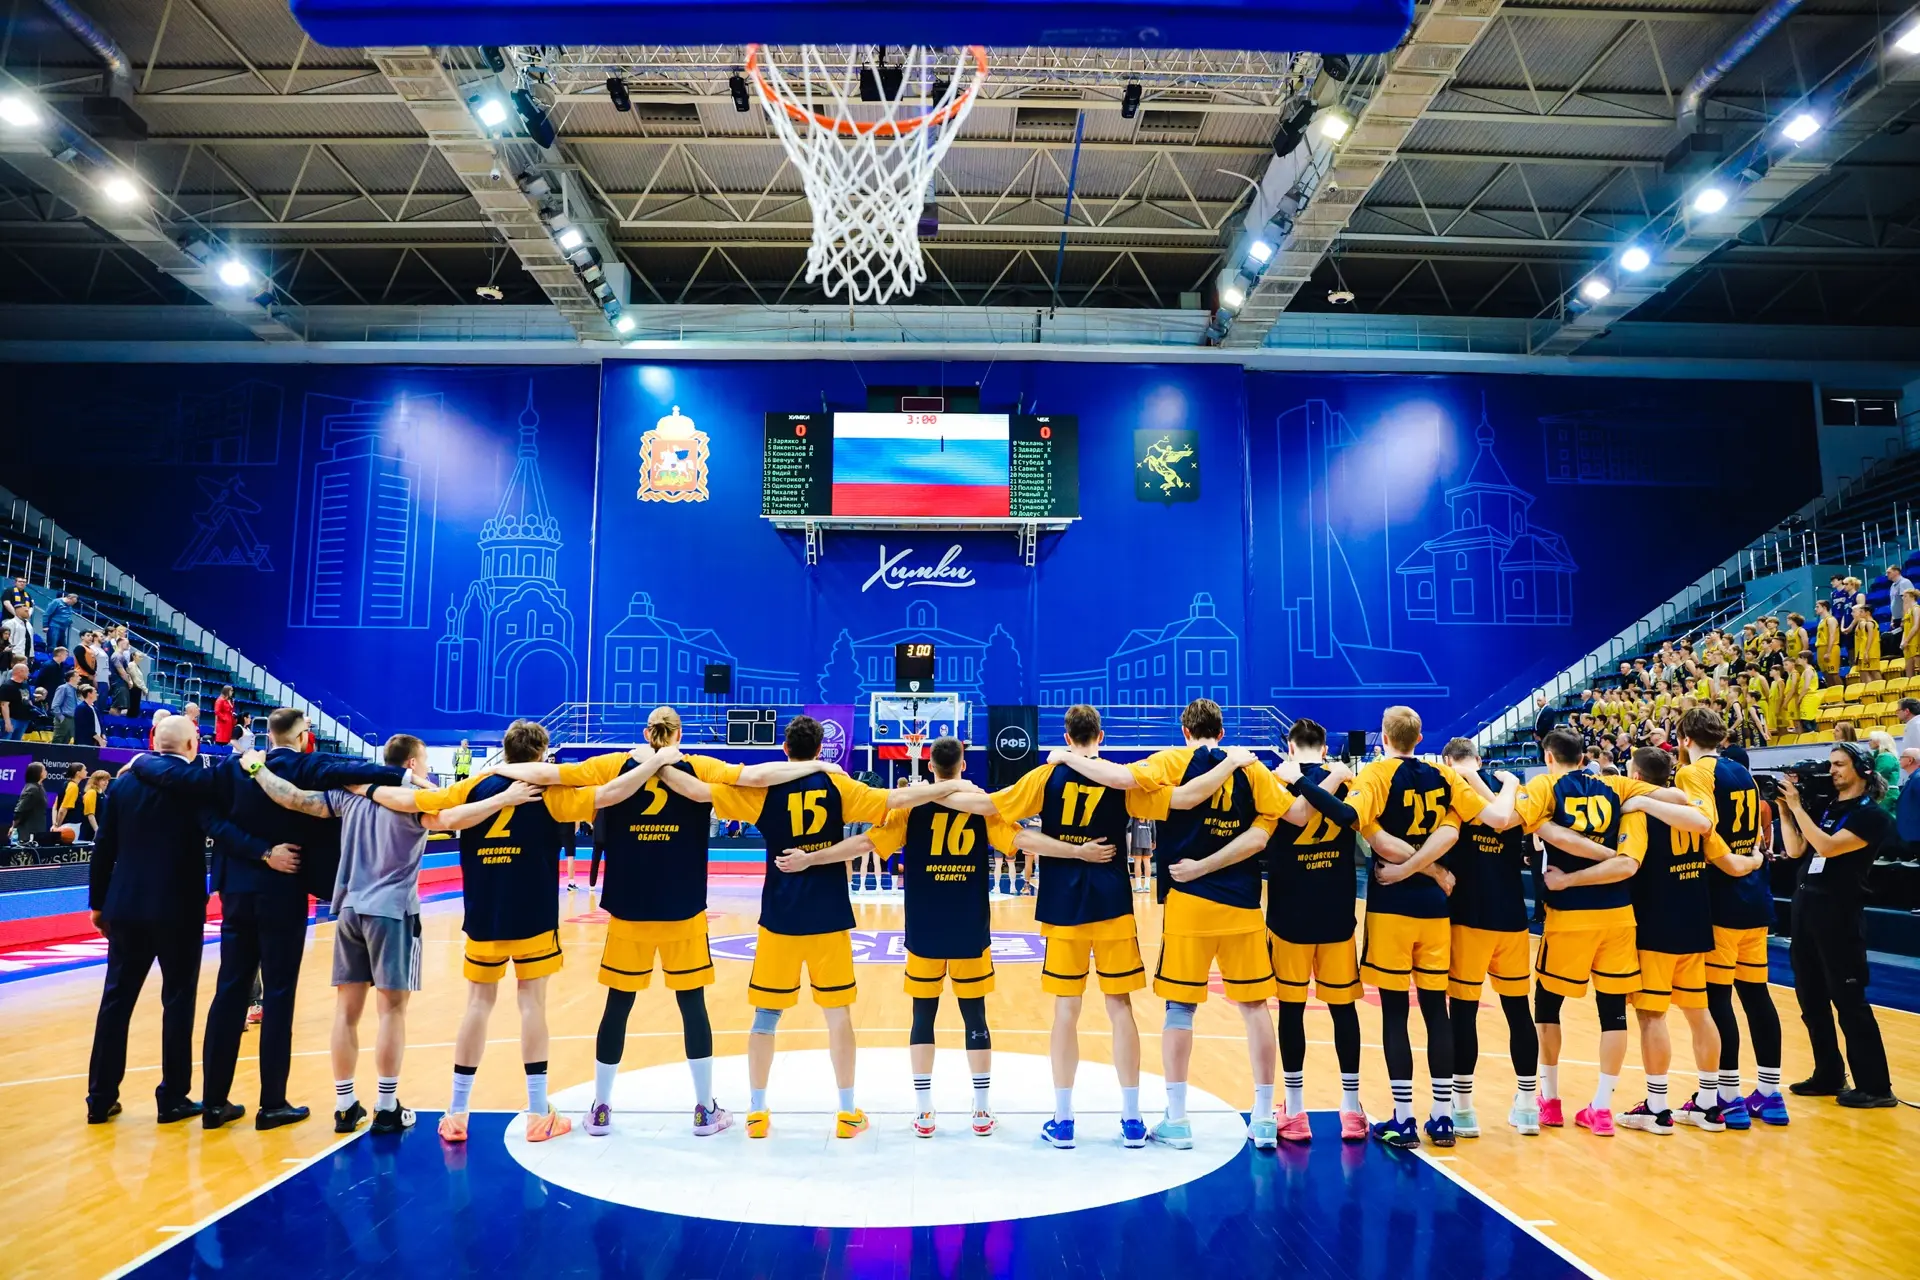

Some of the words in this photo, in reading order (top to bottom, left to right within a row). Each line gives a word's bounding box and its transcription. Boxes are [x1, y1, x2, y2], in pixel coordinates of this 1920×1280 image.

[907, 414, 937, 425] 3:00
[795, 424, 807, 437] 0
[1040, 426, 1051, 439] 0
[862, 544, 976, 593] Химки
[1000, 738, 1026, 748] РФБ
[641, 776, 668, 816] 5
[1061, 782, 1106, 827] 17
[1730, 789, 1756, 833] 71
[787, 789, 828, 837] 15
[1403, 787, 1446, 836] 25
[1564, 795, 1612, 832] 50
[485, 805, 516, 839] 2
[630, 824, 680, 832] МОСКОВСКАЯ
[638, 833, 671, 841] ОБЛАСТЬ
[930, 812, 976, 856] 16
[477, 847, 521, 856] МОСКОВСКАЯ
[483, 856, 512, 865] ОБЛАСТЬ
[926, 865, 976, 873] МОСКОВСКАЯ
[934, 873, 967, 882] ОБЛАСТЬ
